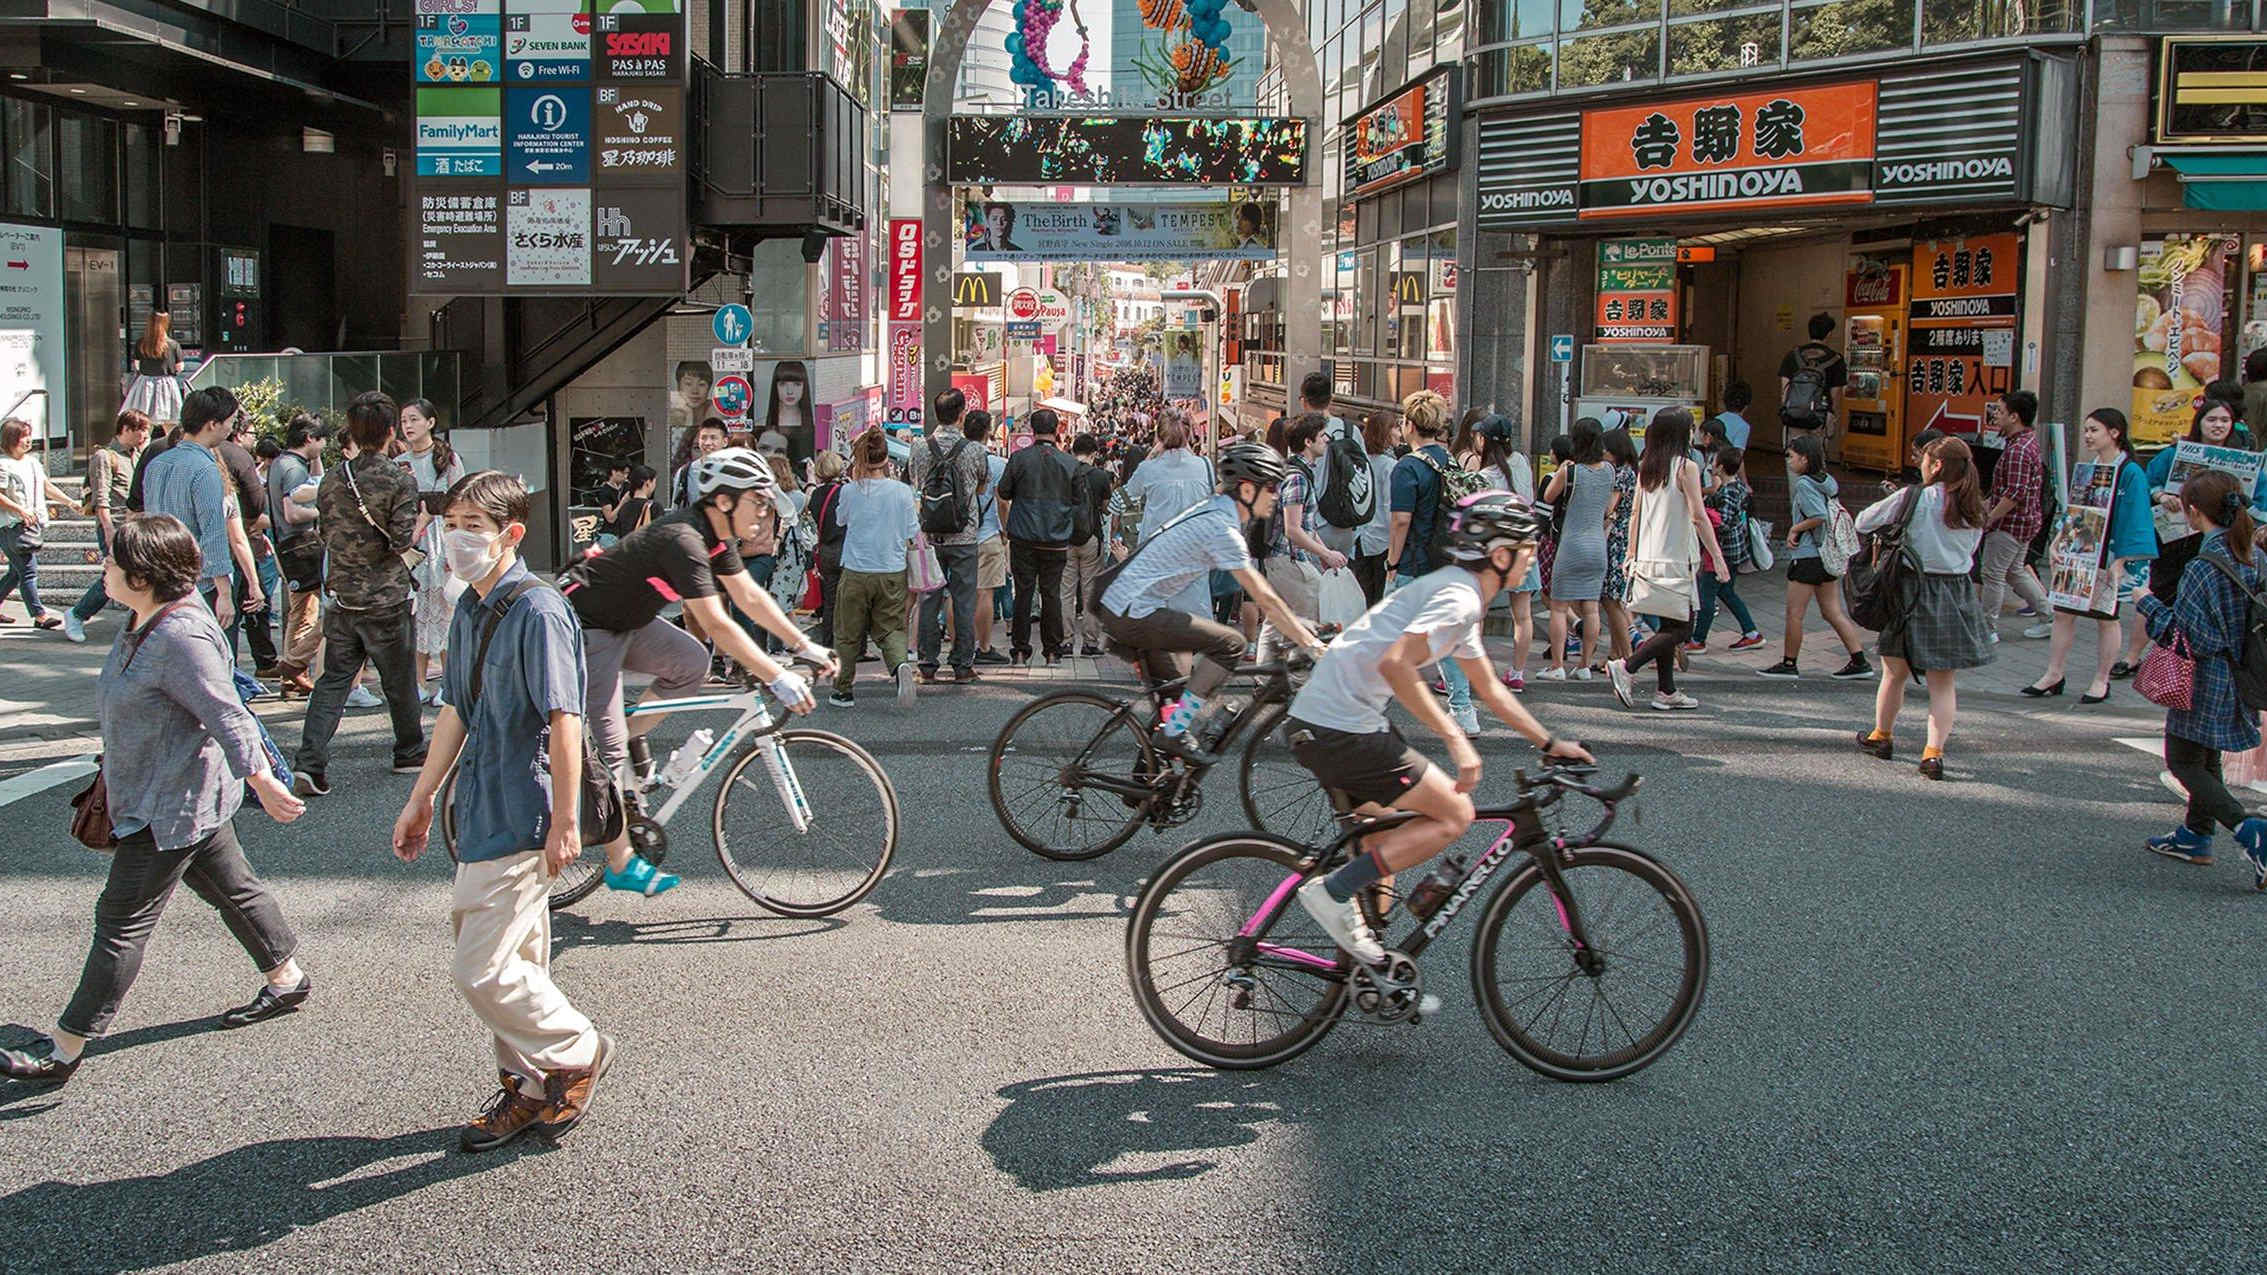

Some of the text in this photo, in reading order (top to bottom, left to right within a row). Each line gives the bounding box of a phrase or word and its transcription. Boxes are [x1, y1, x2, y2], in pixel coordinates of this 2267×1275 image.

[419, 15, 436, 28] 1F
[511, 17, 524, 30] 1F
[600, 16, 616, 30] 1F
[528, 41, 588, 51] SEVEN BANK
[538, 65, 580, 75] Free Wi-Fi
[612, 60, 633, 70] PAS
[644, 60, 666, 70] PAS
[600, 89, 616, 102] BF
[1156, 87, 1233, 111] Street
[615, 99, 663, 114] HAND DRIP
[419, 124, 499, 141] FamilyMart
[604, 136, 673, 144] HOSHINO COFFEE
[1630, 98, 1806, 171] 吉野家
[513, 140, 559, 148] INFORMATION
[601, 148, 677, 168] 星乃珈琲
[435, 157, 484, 175] 酒 たばこ
[555, 162, 573, 171] 20m
[510, 191, 526, 205] BF
[1022, 213, 1088, 228] The Birth
[1160, 213, 1226, 228] TEMPEST
[514, 232, 585, 249] さくら水産
[89, 259, 114, 271] EV-1
[1931, 246, 1993, 291] 吉野家
[1616, 265, 1669, 281] ビリヤード
[1624, 279, 1660, 289] ダーツ
[1605, 297, 1669, 321] 吉野家
[1928, 328, 1984, 347] 2階席ありま
[1910, 356, 2009, 397] 吉野家 入口
[571, 515, 598, 543] 星
